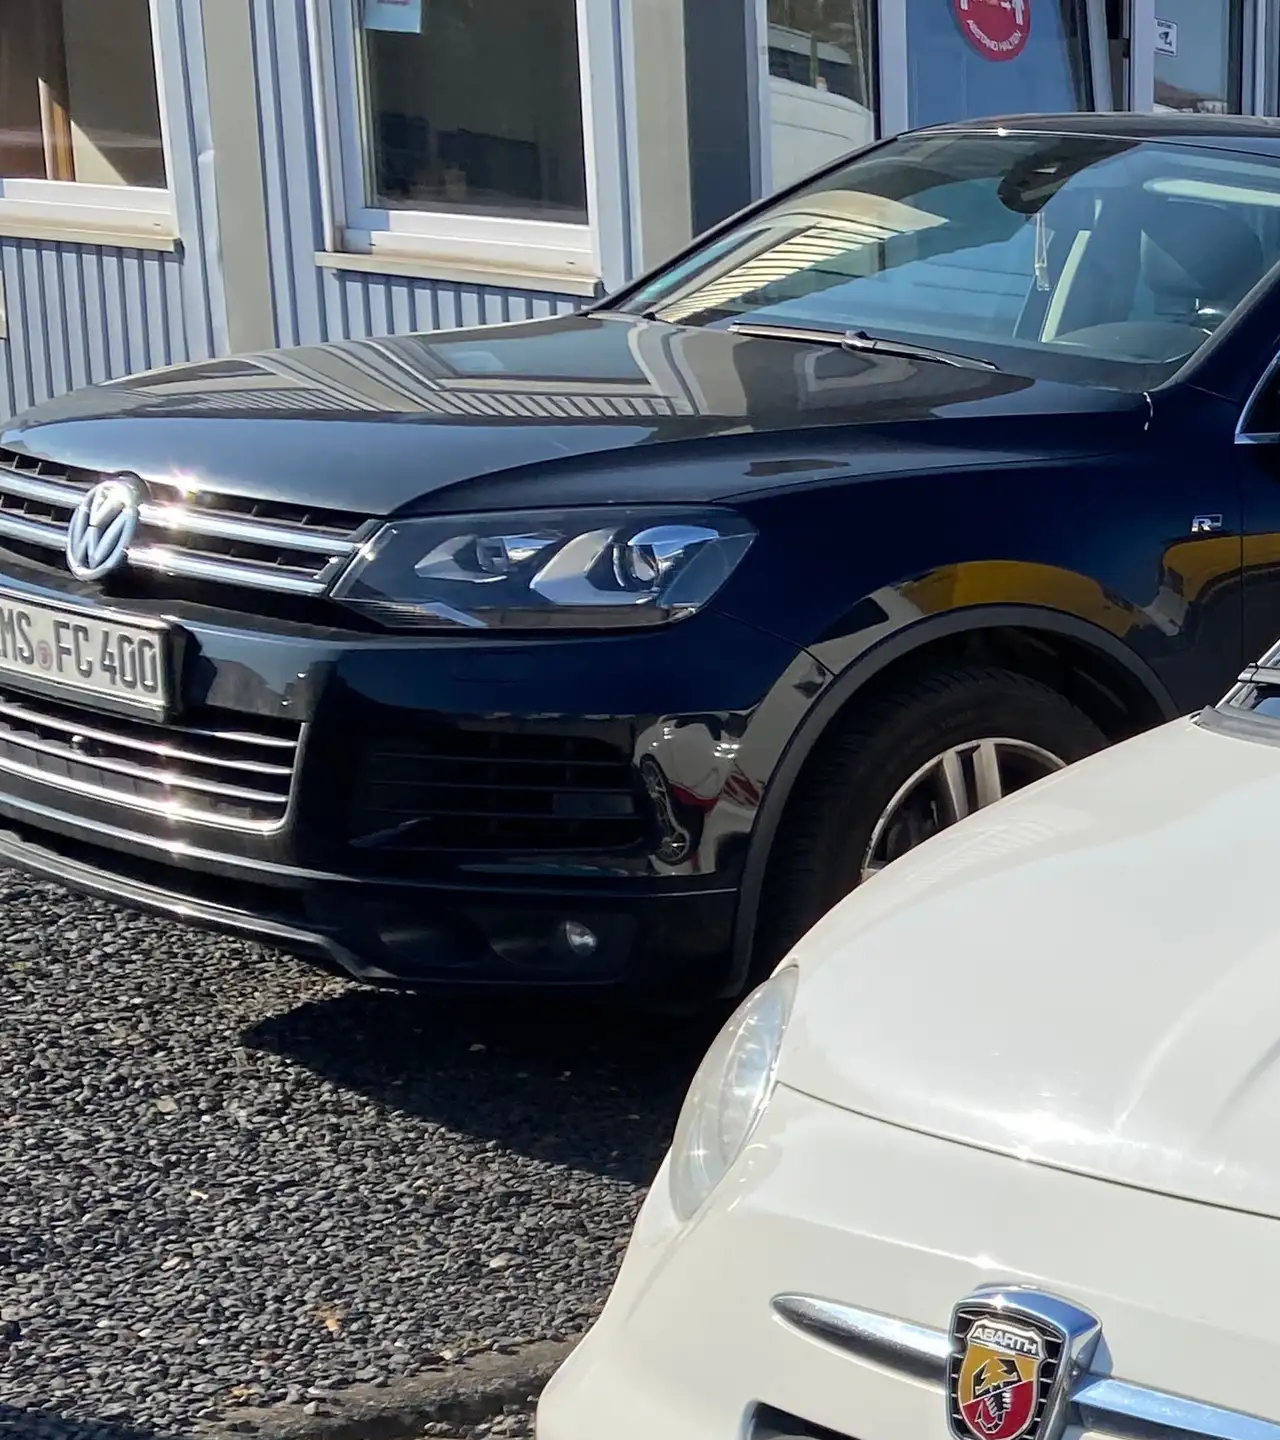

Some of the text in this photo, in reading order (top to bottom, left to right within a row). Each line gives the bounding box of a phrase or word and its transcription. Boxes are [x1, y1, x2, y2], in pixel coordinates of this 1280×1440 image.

[967, 20, 1022, 51] ABSTAND HALTEN
[0, 607, 158, 693] MS FC 400
[973, 1327, 1037, 1354] ABARTH
